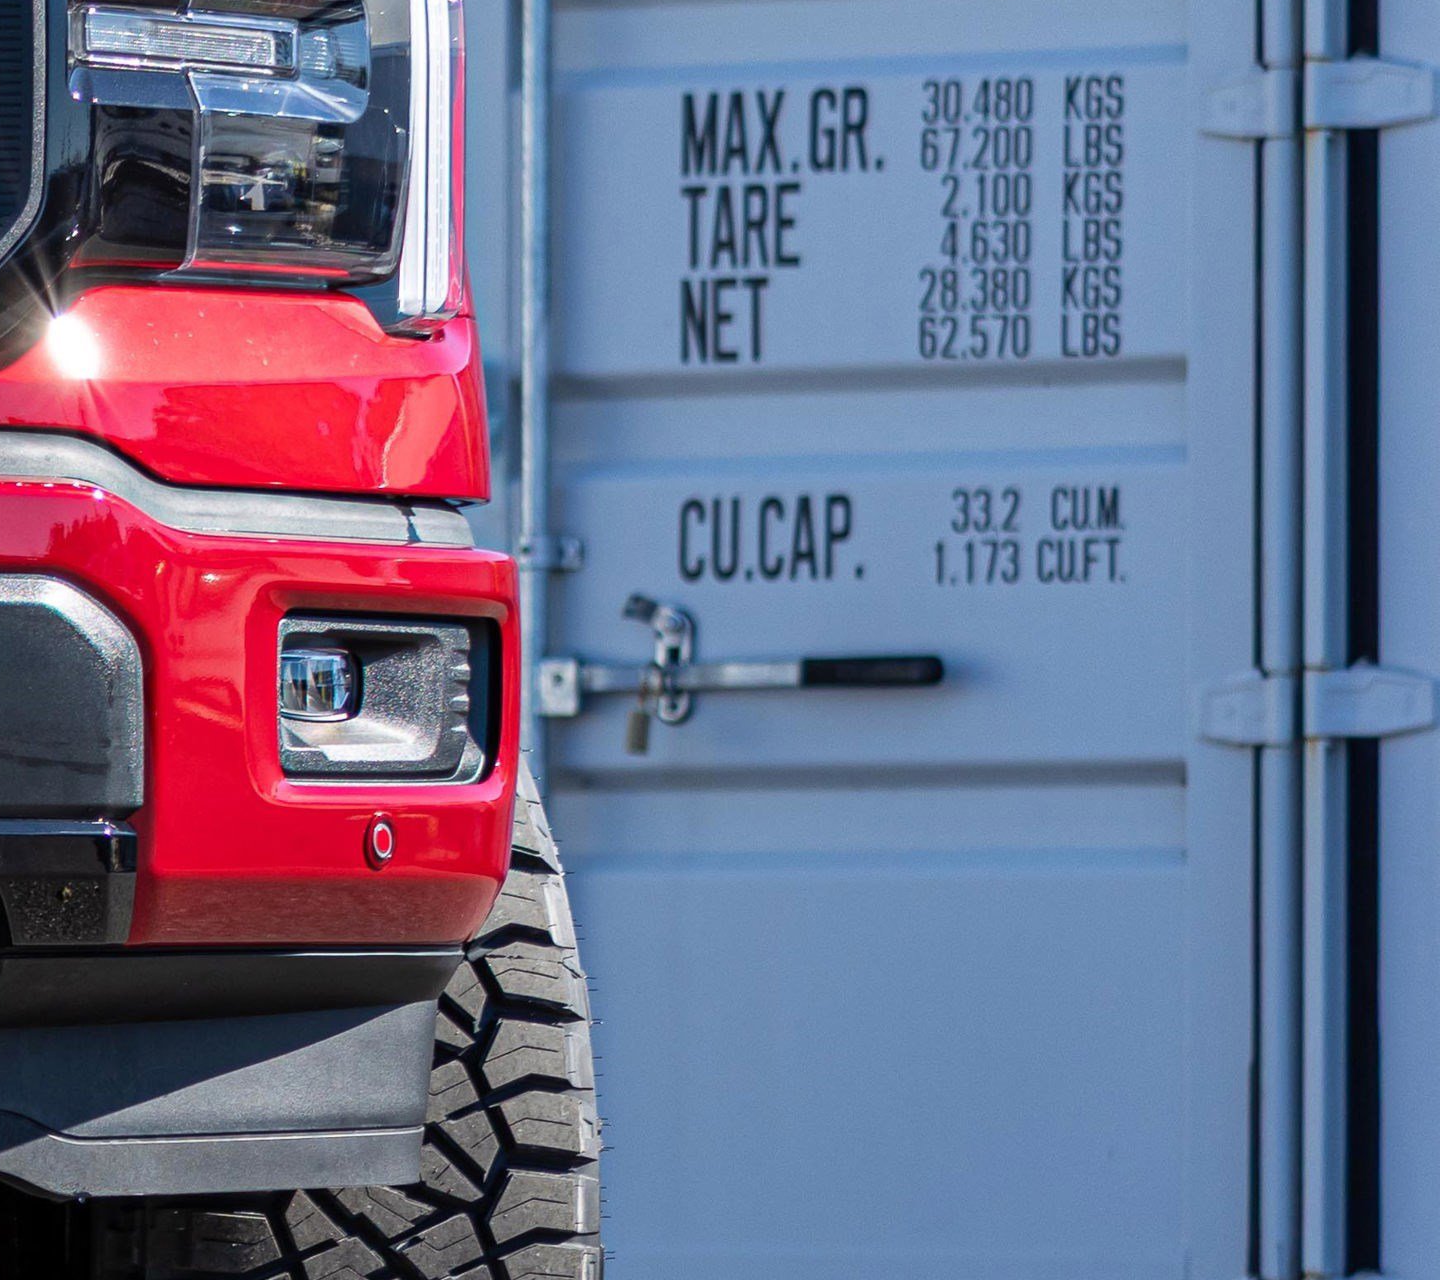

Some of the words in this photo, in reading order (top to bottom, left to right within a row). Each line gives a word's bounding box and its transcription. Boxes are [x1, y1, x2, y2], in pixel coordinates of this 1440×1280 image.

[921, 77, 1035, 124] 30.480
[1063, 74, 1126, 121] KGS
[919, 123, 1035, 172] 67.200
[1062, 122, 1125, 169] LBS
[939, 171, 1034, 219] 2.100
[1062, 170, 1124, 216] KGS
[680, 181, 802, 270] TARE
[939, 219, 1032, 265] 4.630
[1062, 217, 1124, 264] LBS
[918, 266, 1033, 313] 28.380
[1061, 264, 1123, 311] KGS
[680, 276, 770, 364] NET
[917, 312, 1032, 361] 62.570
[1060, 311, 1123, 358] LBS
[950, 485, 1022, 533] 33.2
[678, 492, 866, 583] CU.CAP.
[934, 538, 1021, 585] 1.173
